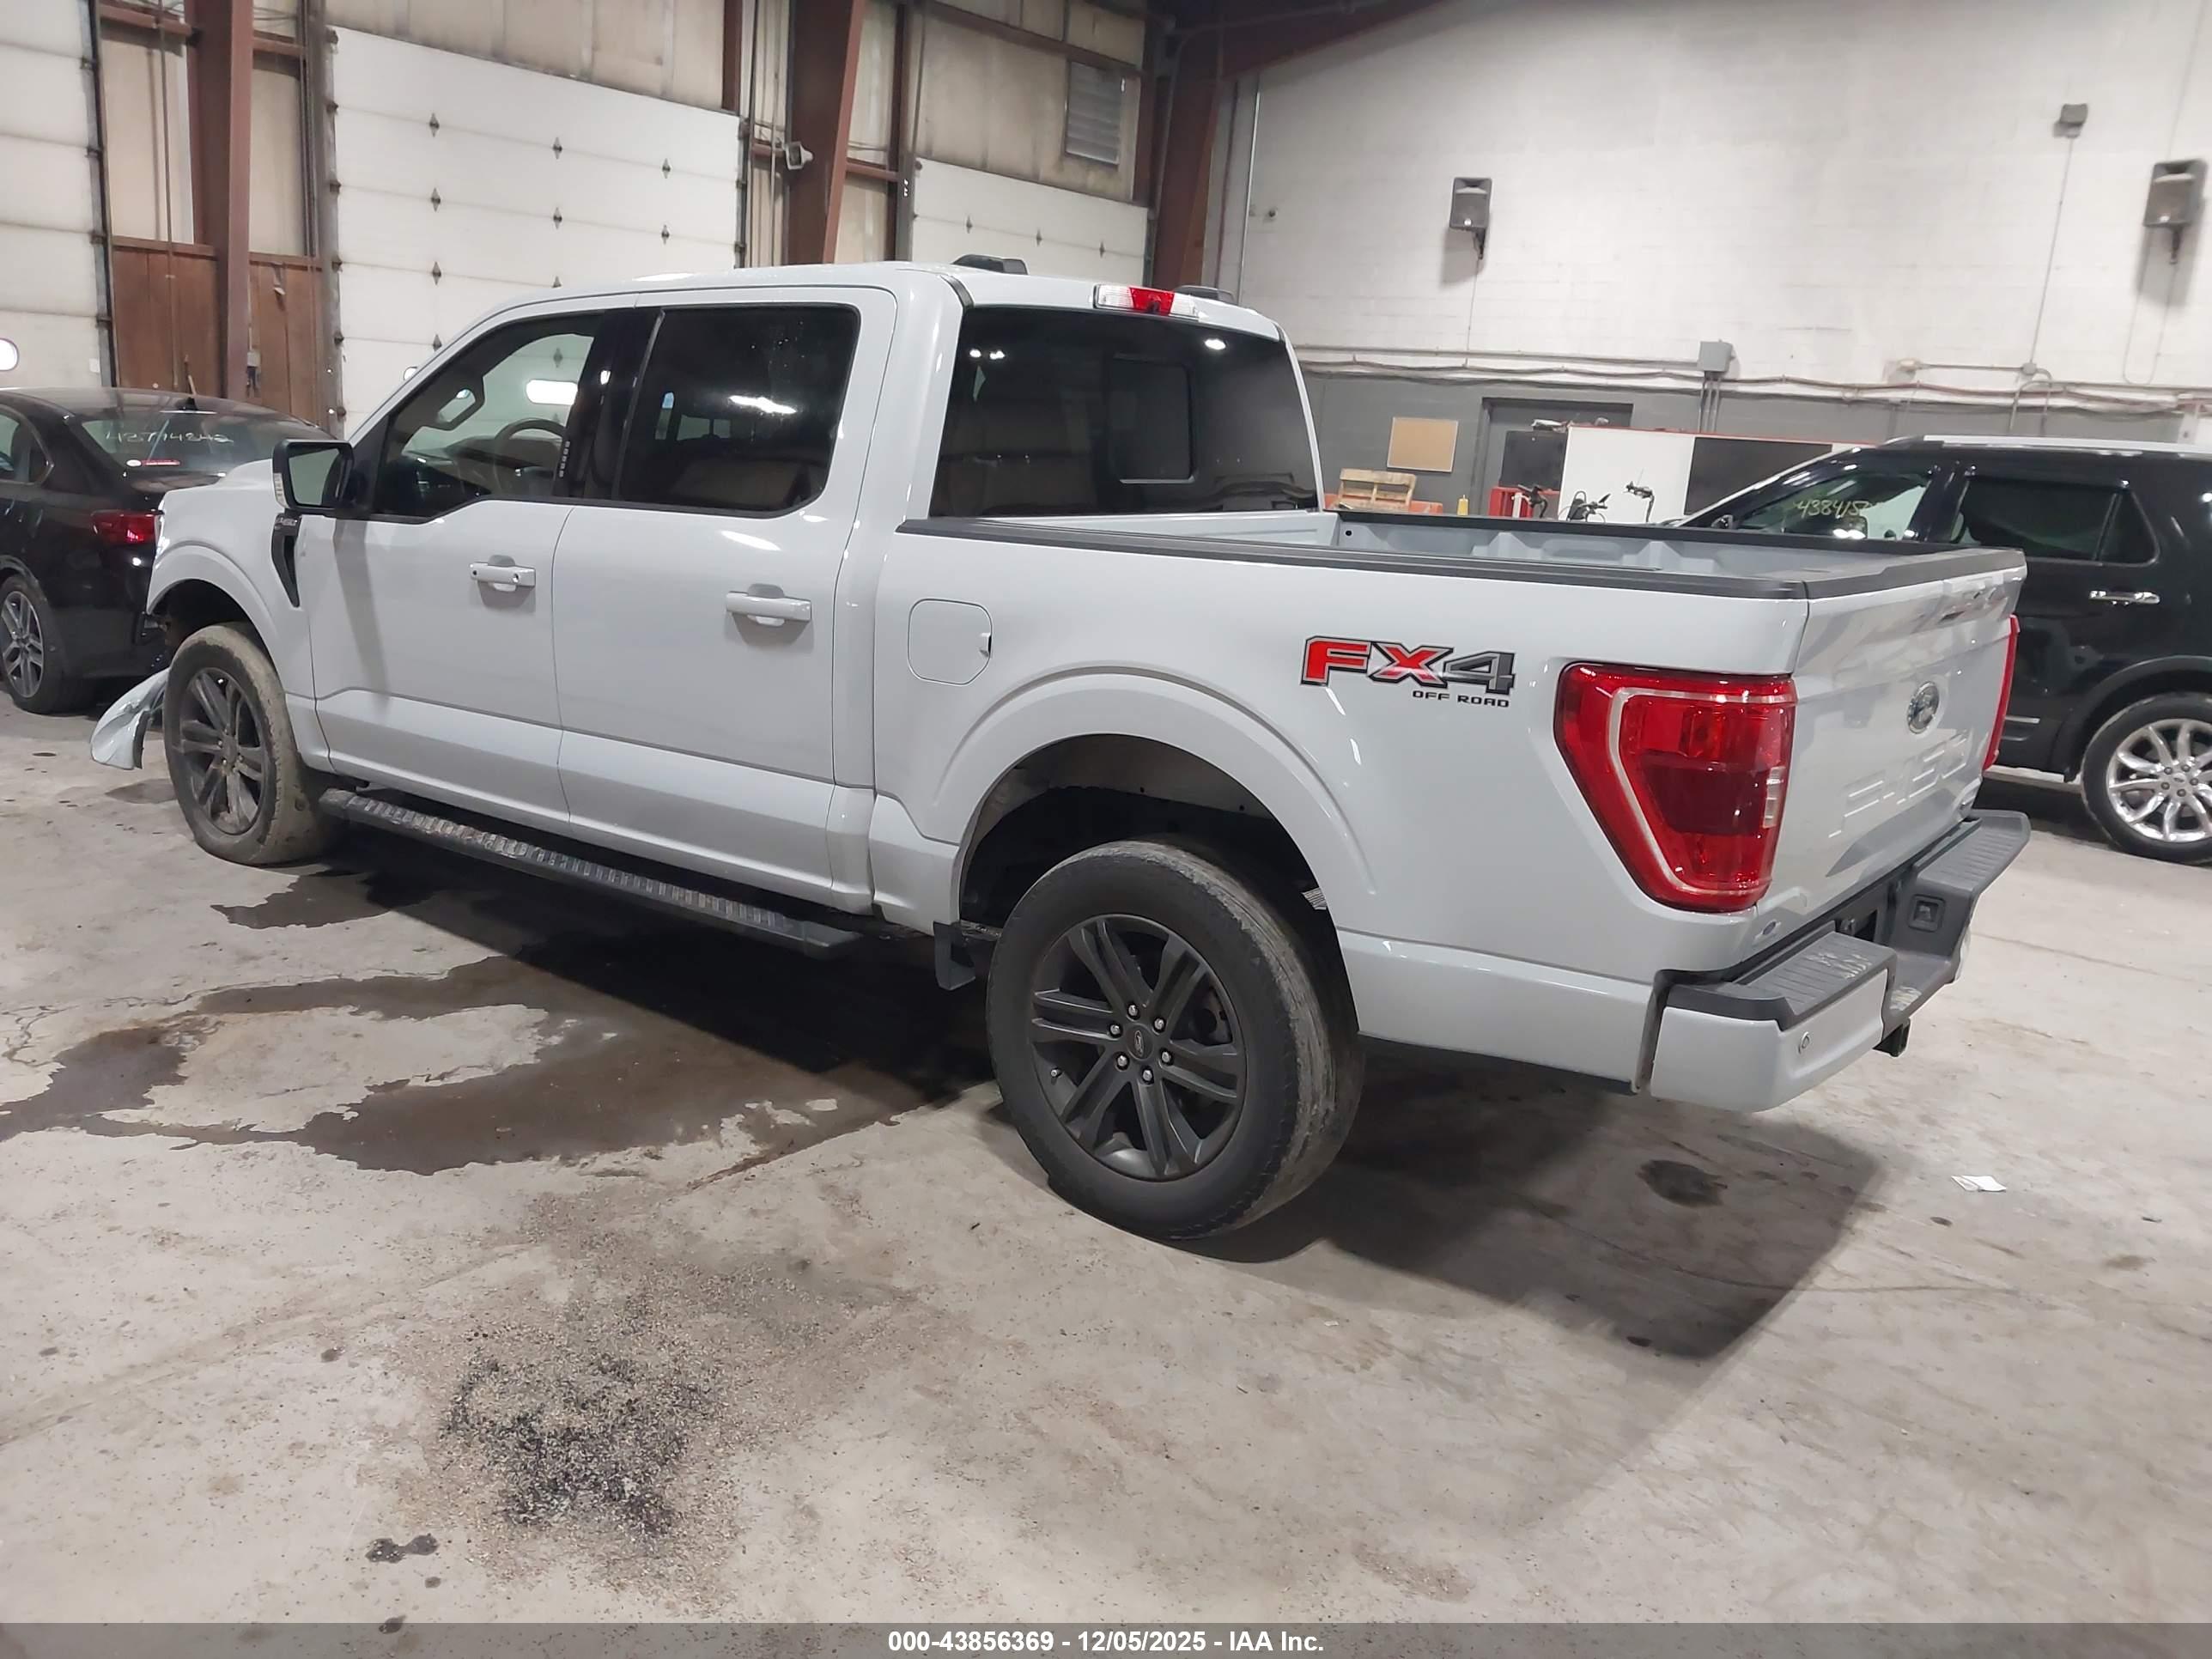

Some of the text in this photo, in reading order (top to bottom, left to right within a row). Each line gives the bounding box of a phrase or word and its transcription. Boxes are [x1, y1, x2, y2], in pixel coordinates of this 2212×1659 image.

[1300, 635, 1515, 695] FX4
[1413, 690, 1510, 708] OFF ROAD
